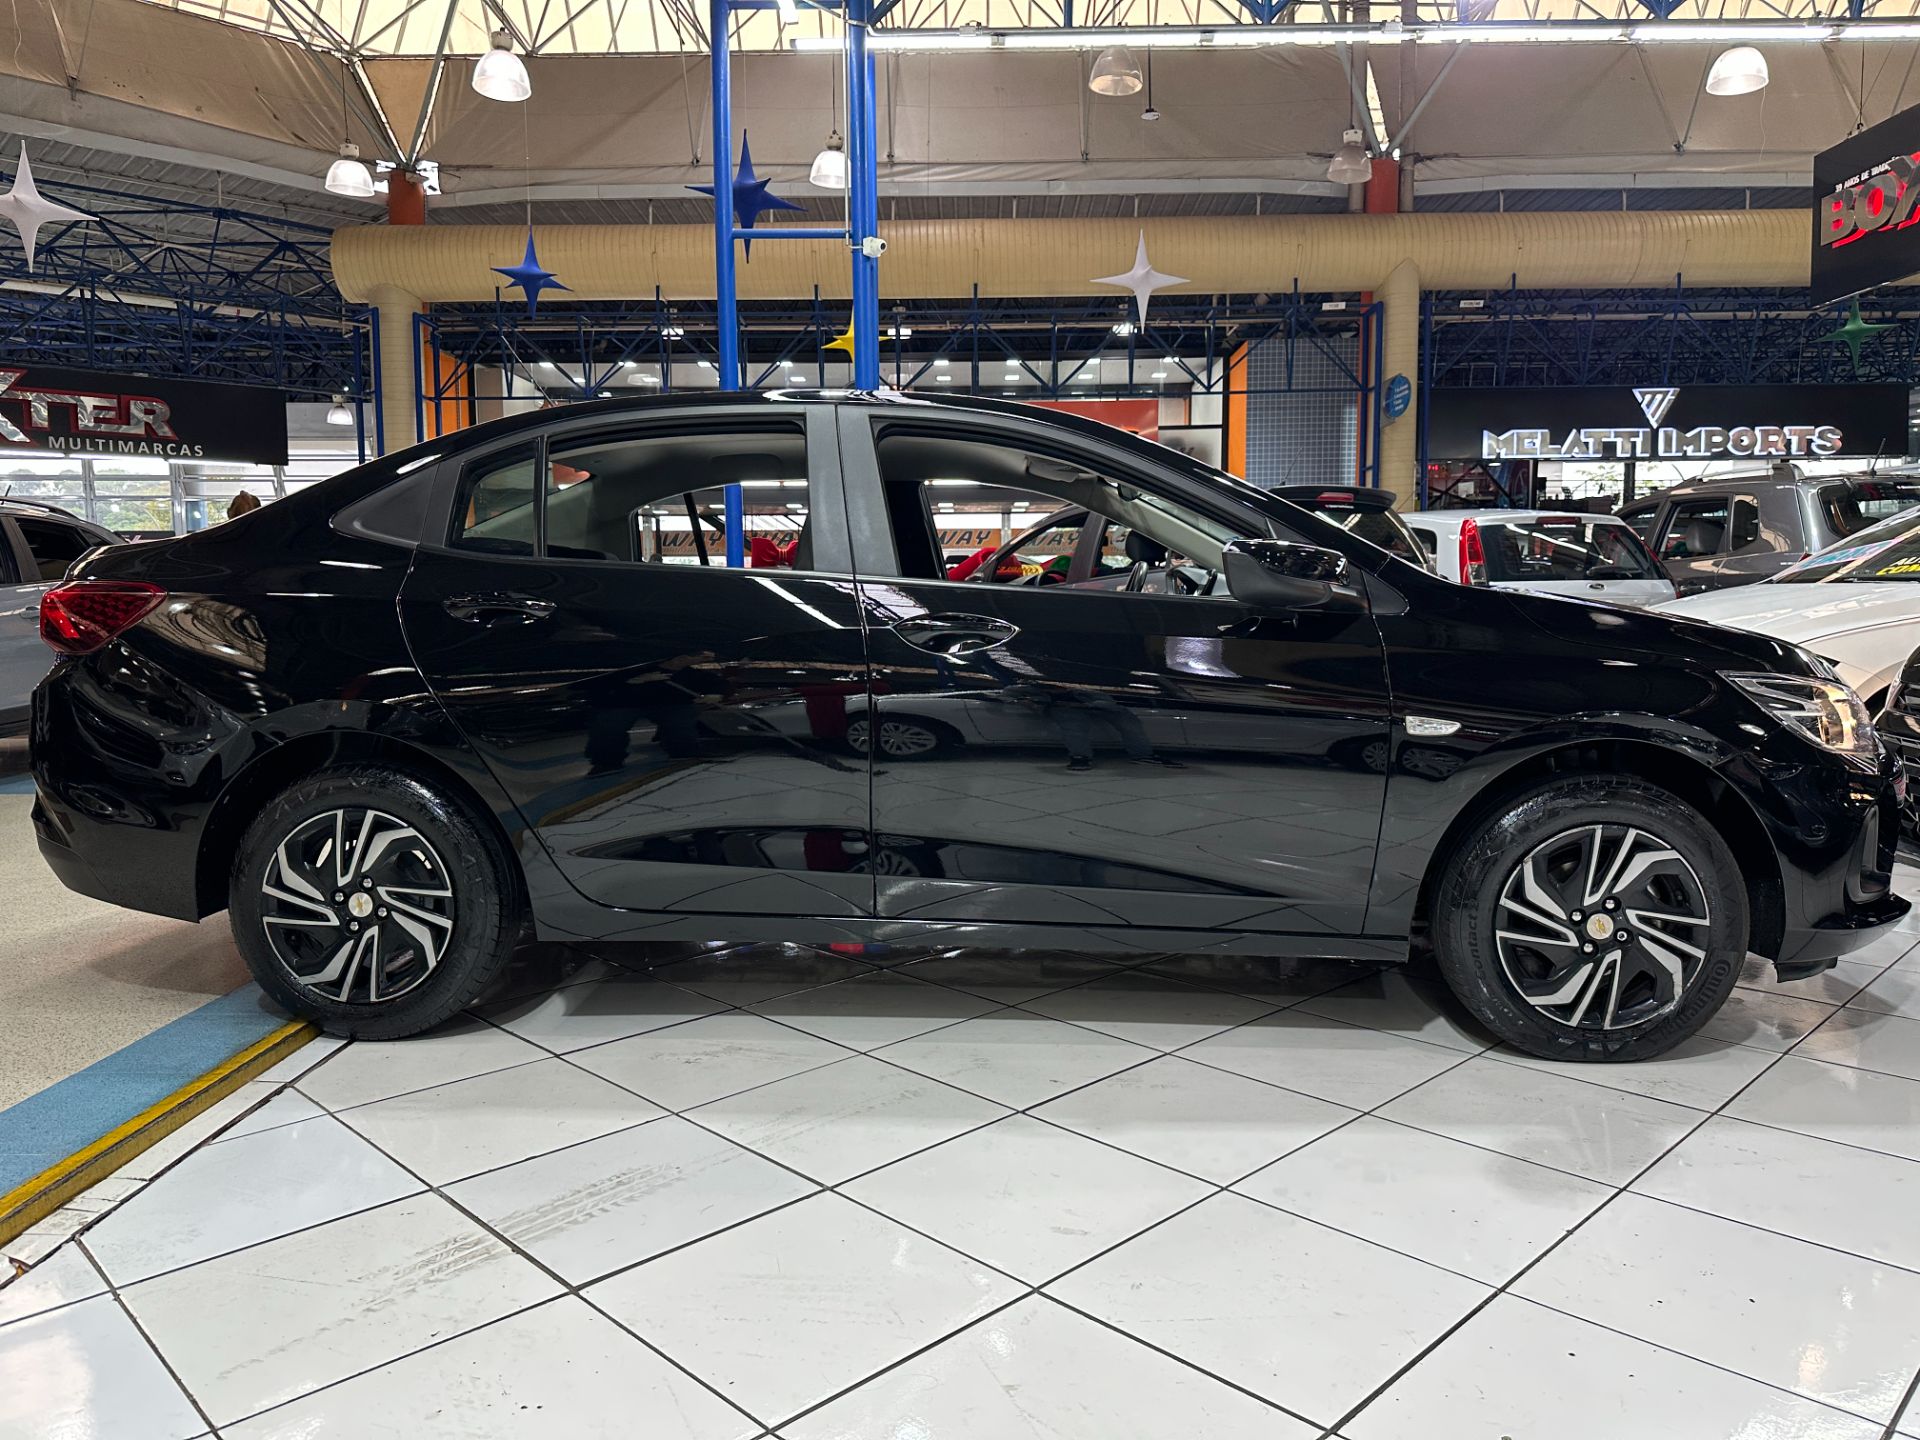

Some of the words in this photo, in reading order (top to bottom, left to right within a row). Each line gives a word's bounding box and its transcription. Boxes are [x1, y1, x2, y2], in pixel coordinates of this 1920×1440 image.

[1861, 170, 1871, 181] DE
[48, 436, 204, 457] MULTIMARCAS
[1482, 428, 1651, 459] MELATTI
[1658, 426, 1844, 457] IMPORTS
